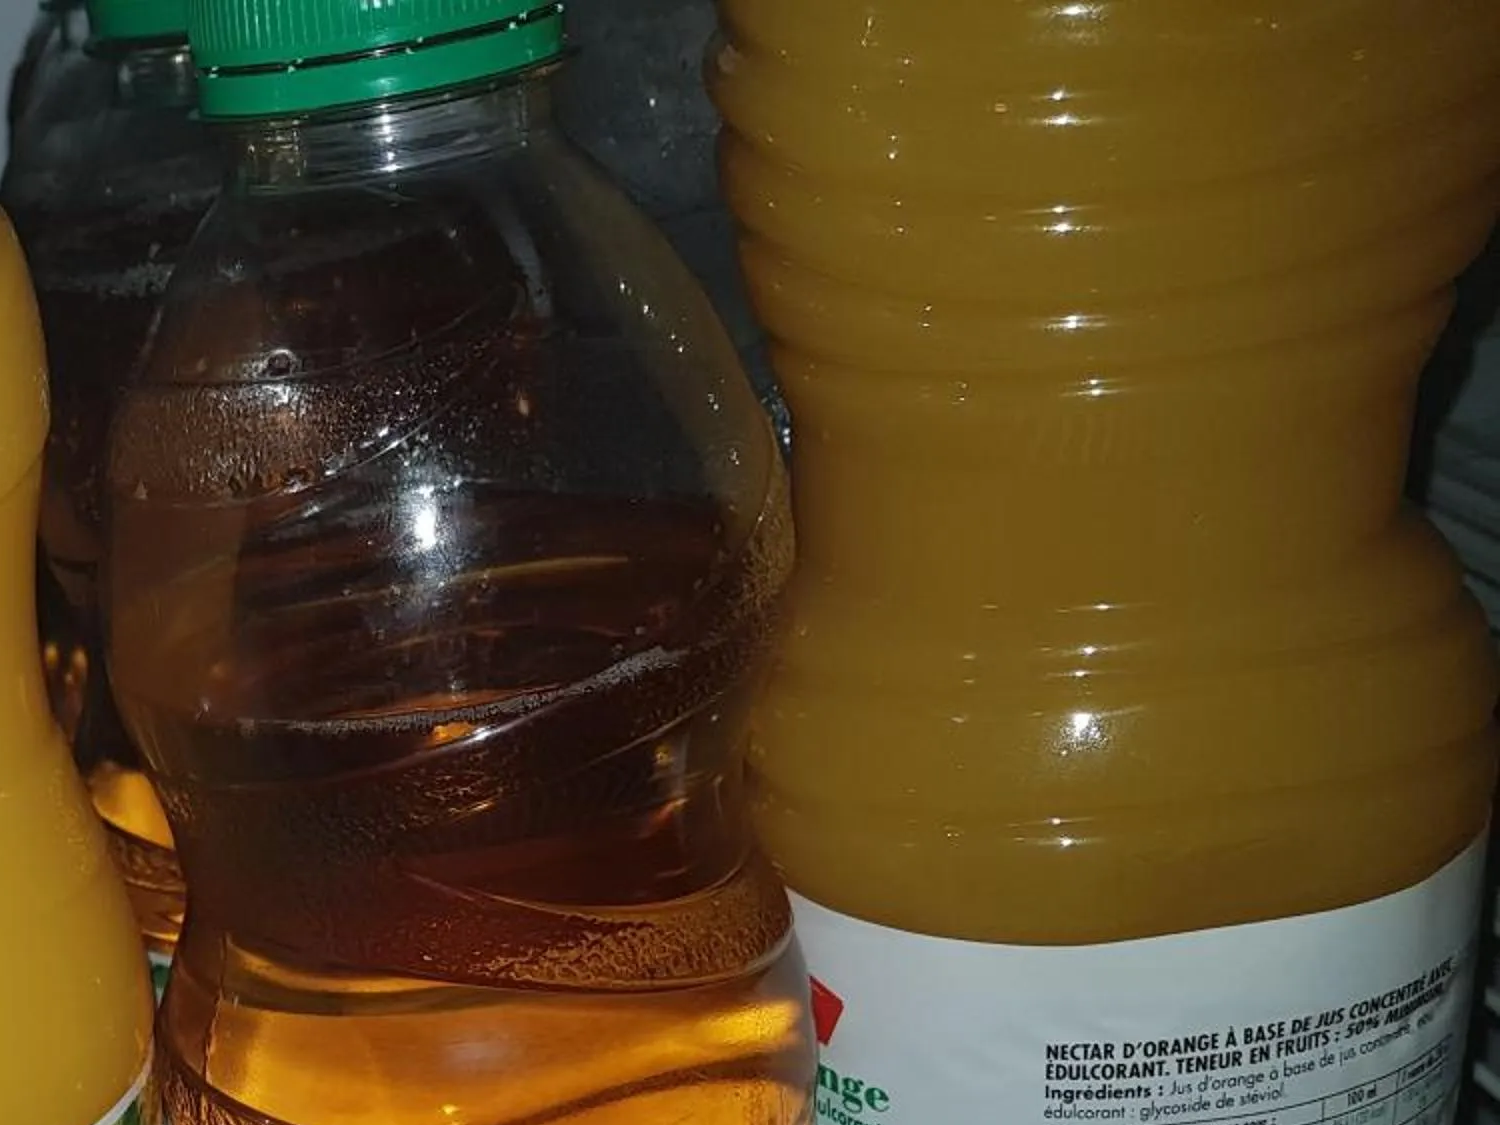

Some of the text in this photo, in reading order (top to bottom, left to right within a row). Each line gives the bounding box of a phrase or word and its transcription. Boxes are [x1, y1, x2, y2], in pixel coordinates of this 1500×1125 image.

[1045, 1060, 1171, 1081] ÉDULCORANT.
[1175, 1050, 1243, 1075] TENEUR
[1249, 1045, 1271, 1065] EN
[1276, 1030, 1330, 1059] FRUITS
[1345, 1013, 1380, 1039] 50%
[1046, 1043, 1115, 1061] NECTAR
[1123, 1033, 1219, 1060] D'ORANGE
[1225, 1025, 1238, 1048] À
[1243, 1021, 1286, 1045] BASE
[1291, 1016, 1312, 1035] DE
[1315, 1007, 1346, 1029] JUS
[1349, 972, 1426, 1019] CONCENTRÉ
[1043, 1103, 1126, 1120] édulcorant
[1139, 1099, 1211, 1122] glycoside
[1215, 1092, 1235, 1109] de
[1044, 1083, 1151, 1104] Ingrédients
[1170, 1080, 1193, 1096] Jus
[1197, 1071, 1265, 1093] d'orange
[1283, 1059, 1316, 1077] base
[1319, 1048, 1335, 1068] de
